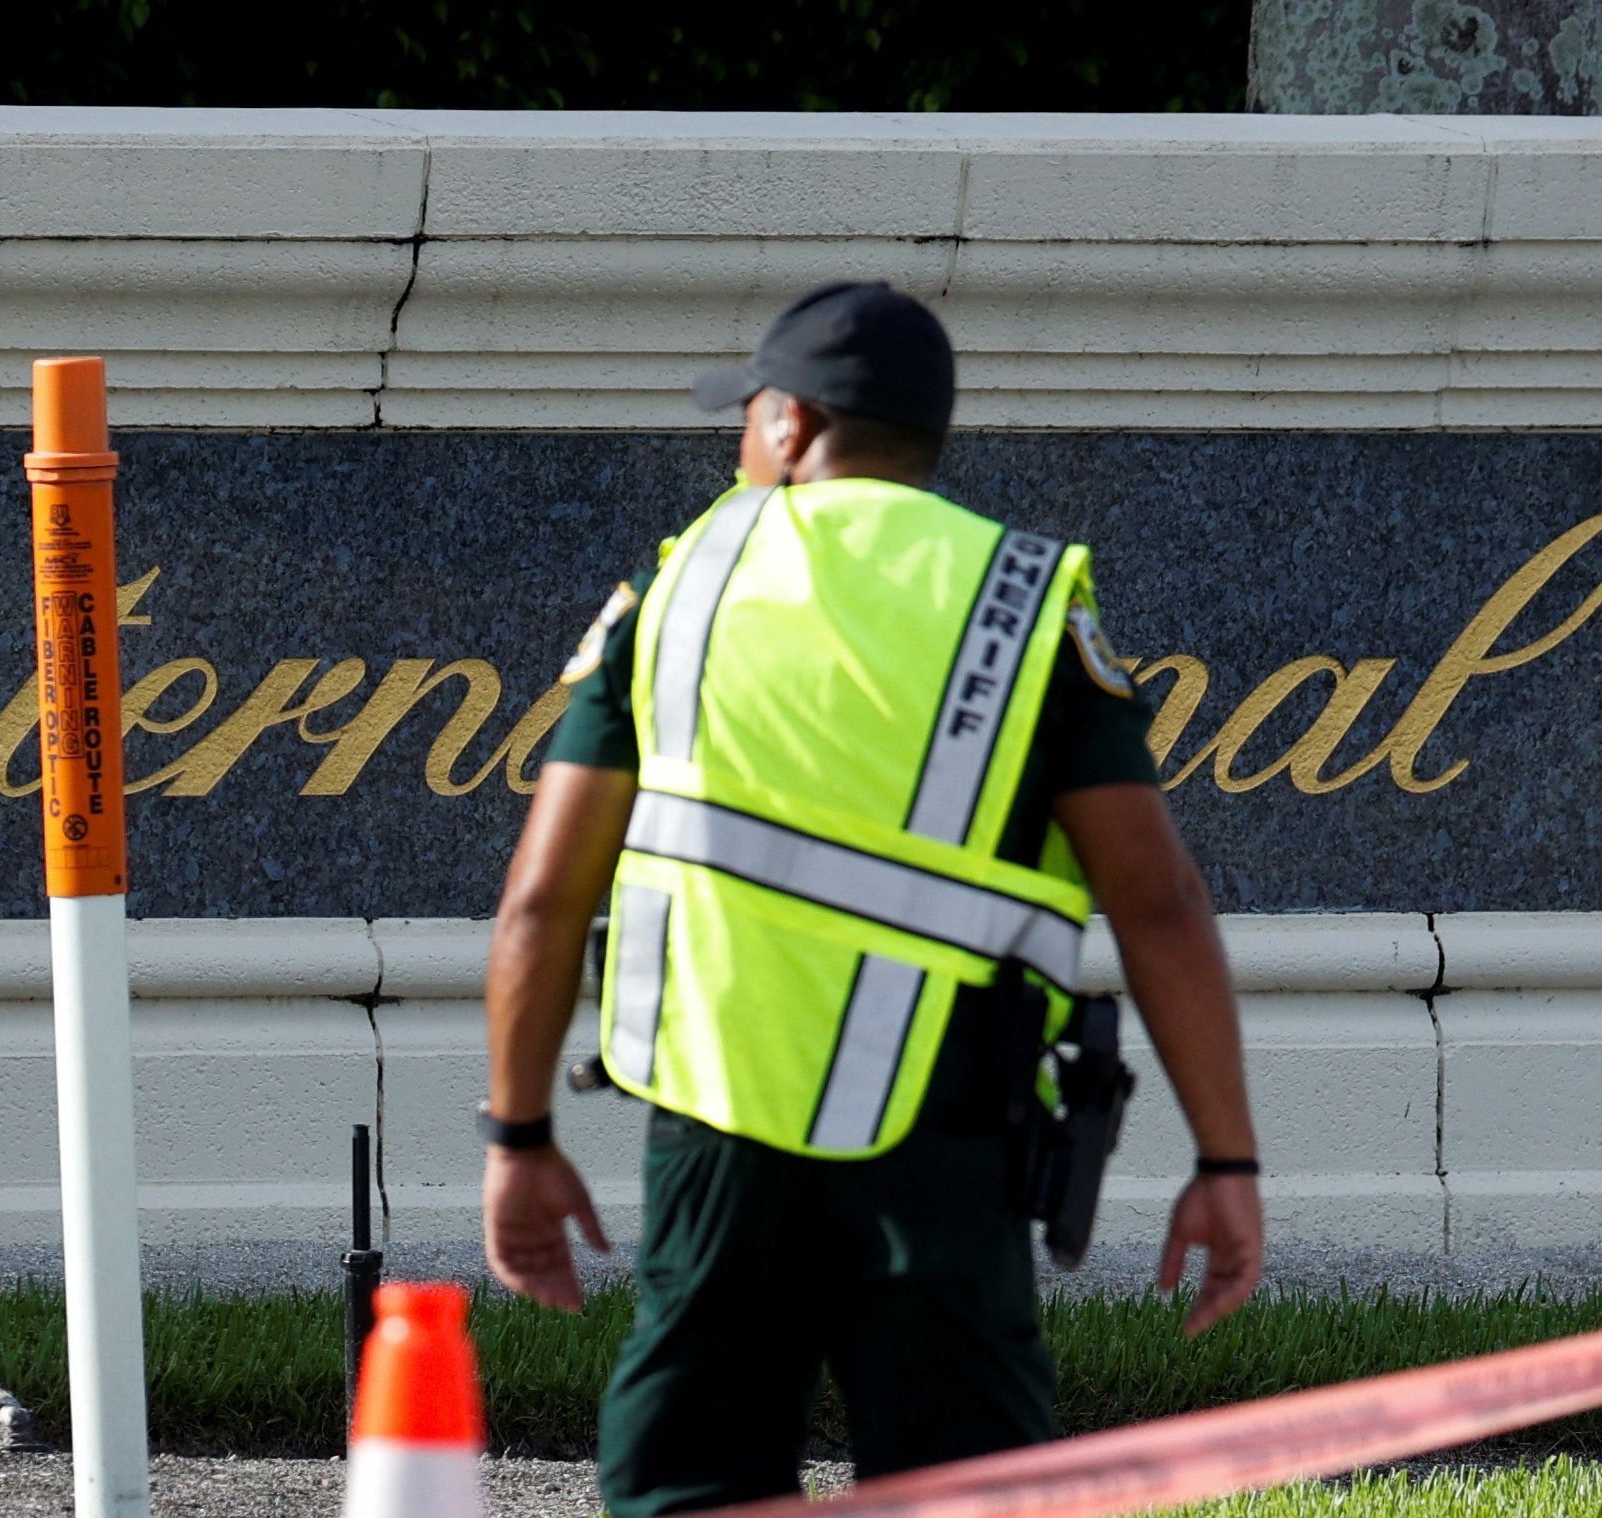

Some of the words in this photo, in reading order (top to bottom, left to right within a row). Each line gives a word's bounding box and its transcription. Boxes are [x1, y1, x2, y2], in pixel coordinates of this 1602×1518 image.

[42, 597, 56, 704] FIBER
[54, 597, 79, 755] WARNING
[79, 593, 99, 701] CABLE
[45, 713, 61, 817] OPTIC
[85, 707, 103, 814] ROUTE
